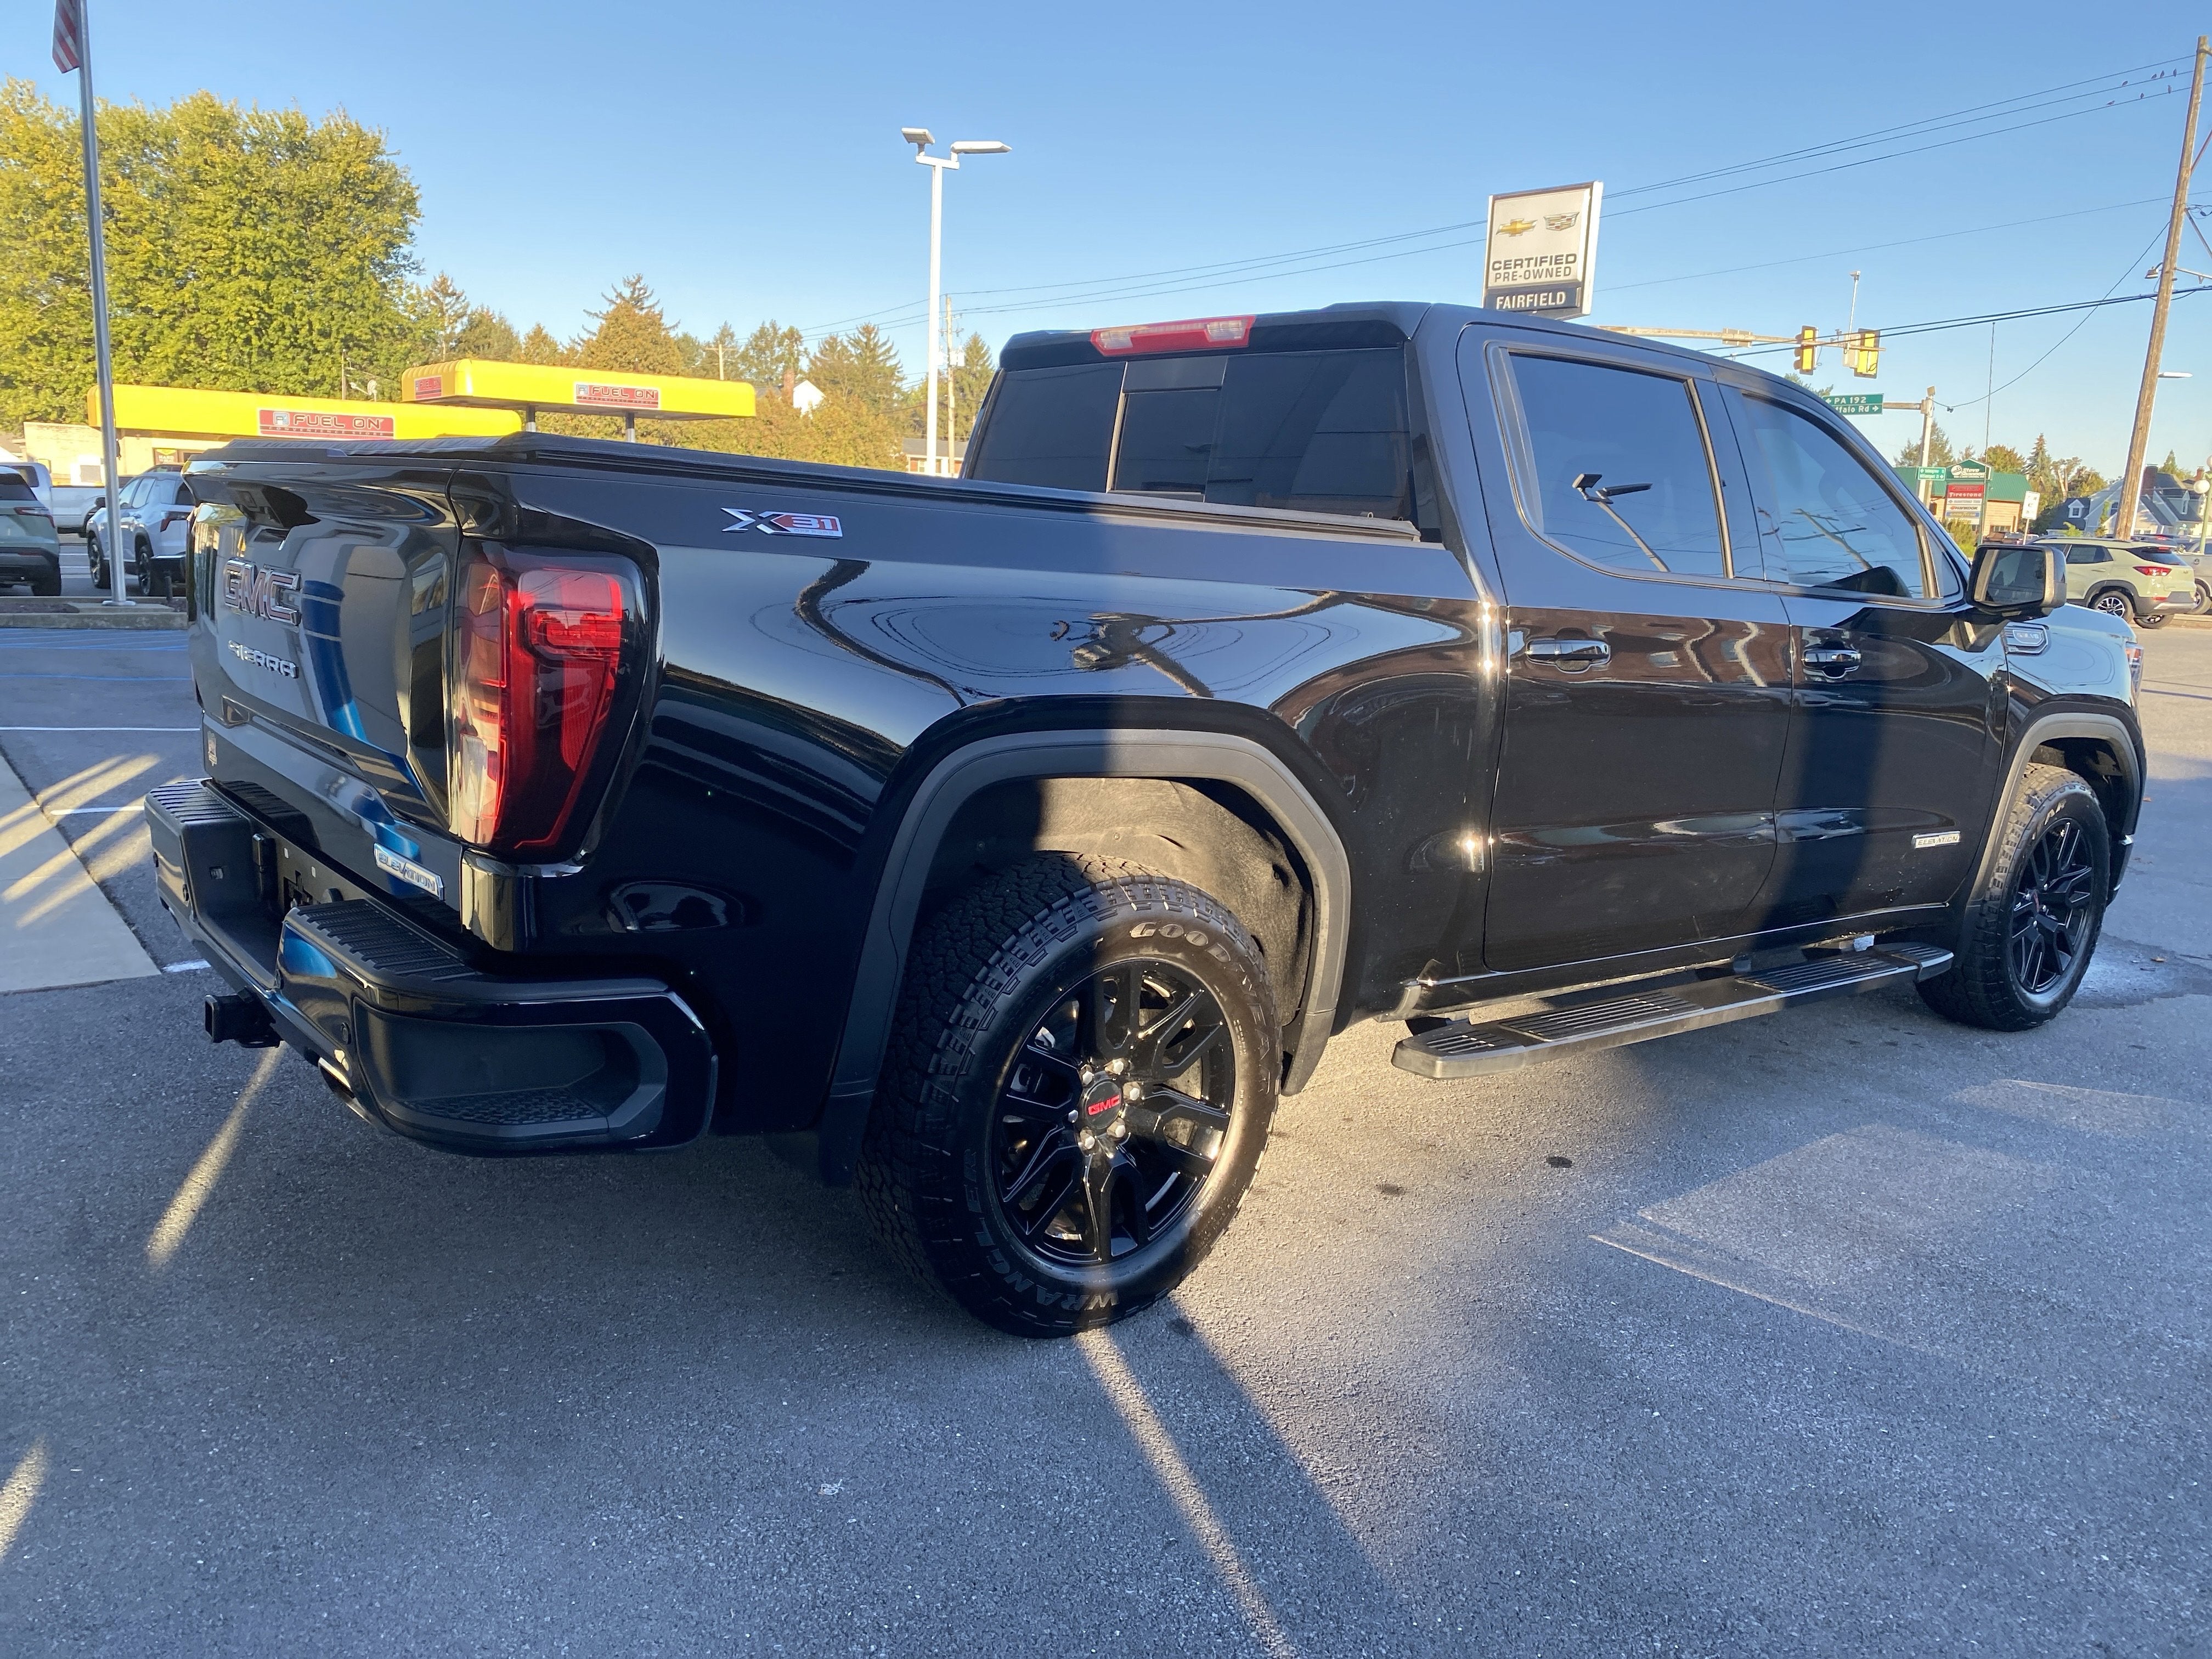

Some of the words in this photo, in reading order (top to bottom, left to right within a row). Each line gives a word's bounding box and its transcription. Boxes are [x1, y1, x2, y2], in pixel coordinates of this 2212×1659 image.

[1492, 253, 1577, 271] CERTIFIED
[1495, 266, 1571, 283] PRE-OWNED
[1496, 291, 1566, 310] FAIRFIELD
[591, 386, 629, 397] FUEL
[635, 389, 656, 399] ON
[294, 414, 346, 428] FUEL
[352, 417, 382, 430] ON
[223, 557, 302, 626] GMC
[228, 640, 299, 679] SIERRA
[1917, 836, 1958, 845] ELEVATION
[379, 853, 435, 891] ELEVATION
[1088, 1094, 1120, 1115] GMC
